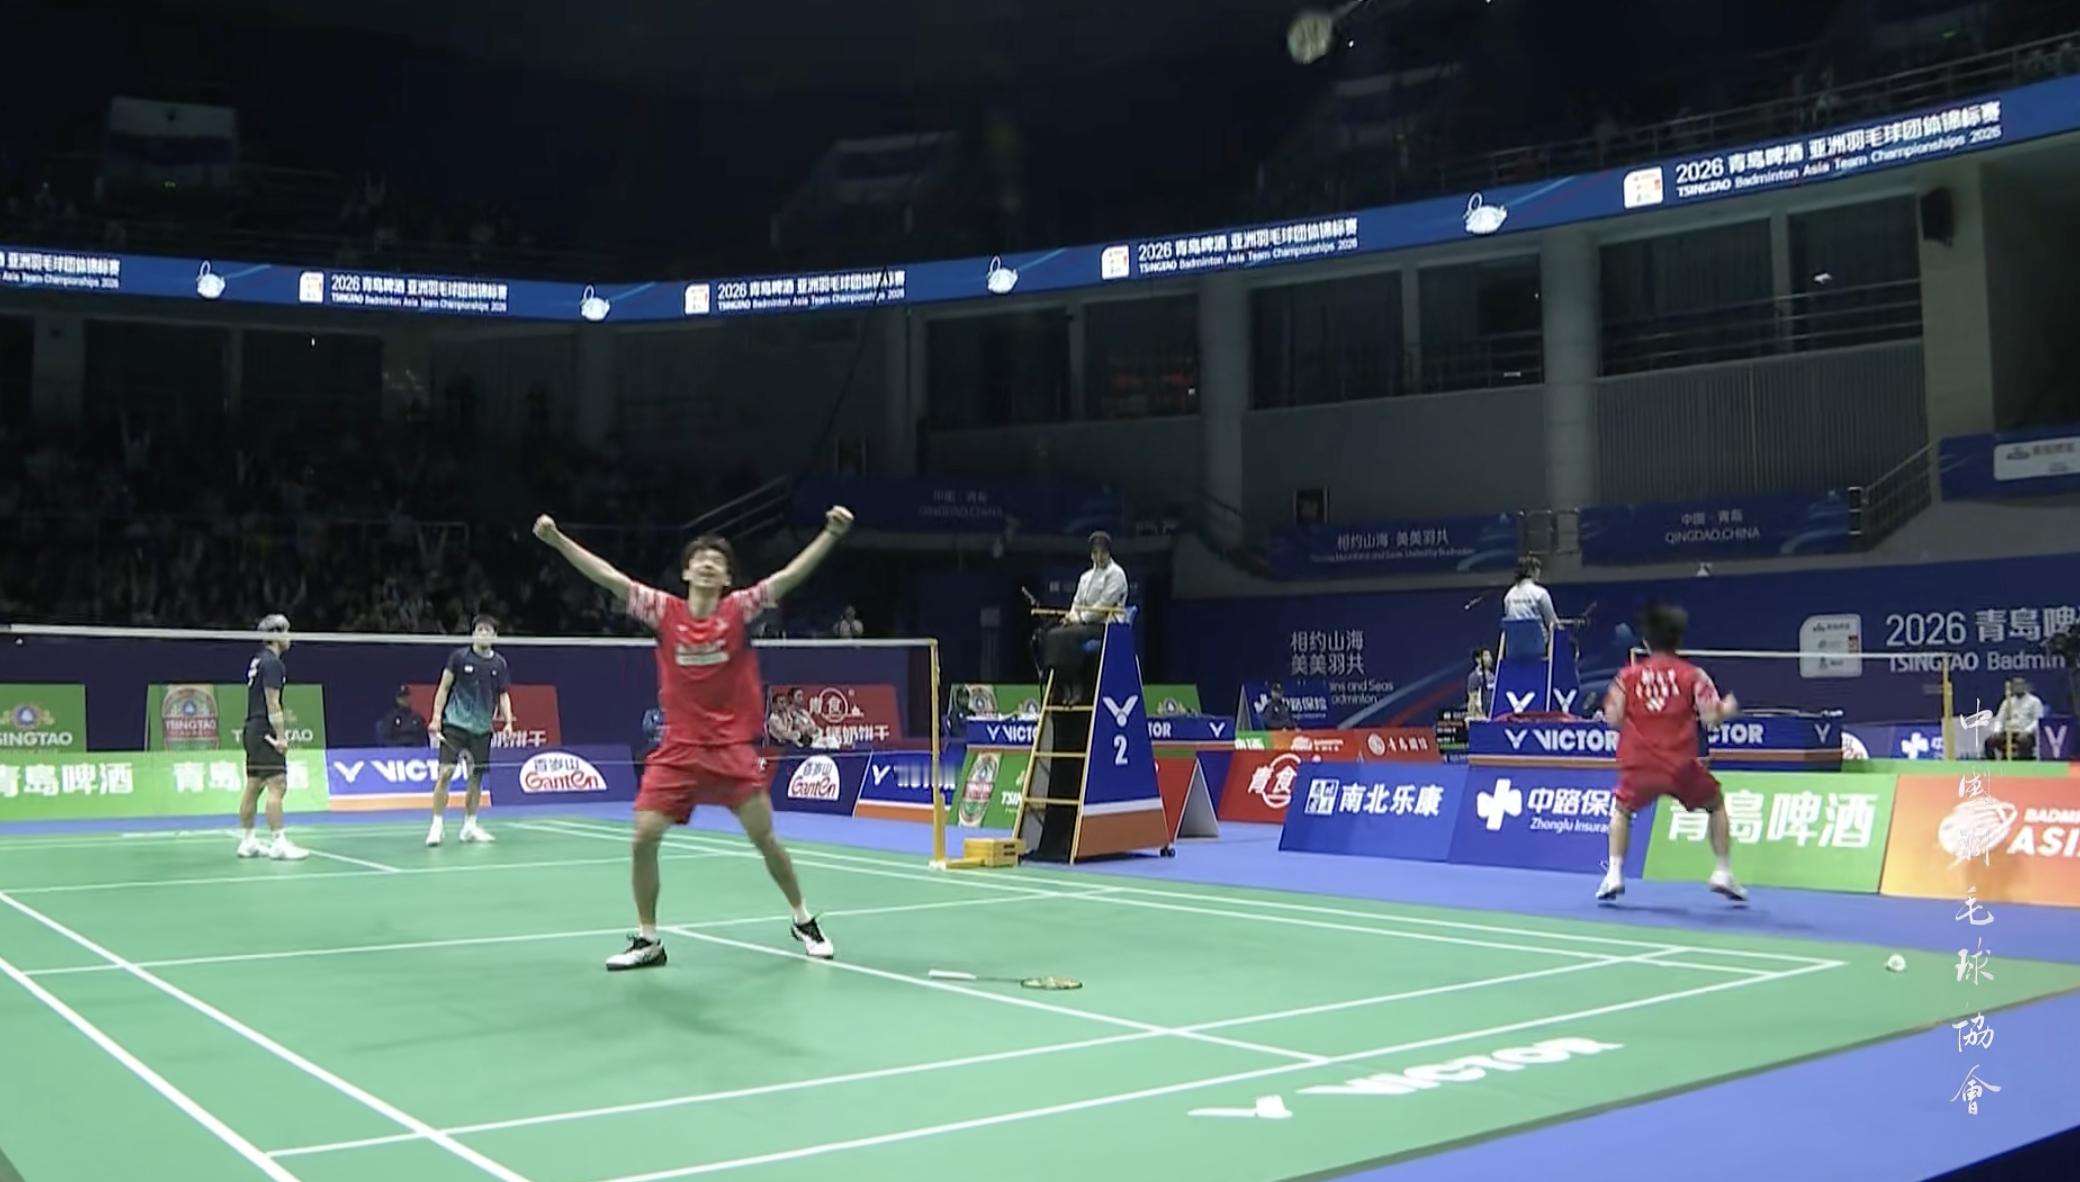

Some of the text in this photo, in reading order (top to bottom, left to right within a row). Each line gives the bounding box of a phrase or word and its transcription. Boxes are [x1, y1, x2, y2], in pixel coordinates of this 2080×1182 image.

[1675, 101, 2001, 184] 2026 青岛啤酒 亚洲羽毛球团体锦标赛
[1677, 179, 1731, 198] TSINGTAO
[1735, 166, 1799, 189] Badminton
[1802, 160, 1829, 179] Asia
[1834, 154, 1867, 172] Team
[1870, 134, 1966, 165] Championships
[1970, 125, 2002, 144] 2026
[1137, 243, 1173, 261] 2026
[1179, 256, 1223, 271] Badminton
[1226, 254, 1245, 265] Asia
[1247, 250, 1271, 262] Team
[1272, 241, 1335, 259] Championships
[1337, 237, 1358, 250] 2026
[331, 274, 361, 291] 2026
[717, 283, 747, 299] 2026
[1886, 611, 1967, 646] 2026
[1974, 605, 2080, 643] 青岛啤
[1290, 629, 1364, 653] 相约山海
[1290, 653, 1365, 676] 美美羽共
[1987, 650, 2066, 671] Badmin
[1331, 693, 1378, 705] adminton
[0, 731, 73, 747] SINGTAO
[1113, 734, 1129, 765] 2
[1339, 782, 1444, 817] 南北乐康
[1527, 787, 1616, 817] 中路保
[1530, 817, 1609, 834] Zhonglu Insura
[2006, 825, 2080, 858] ASI
